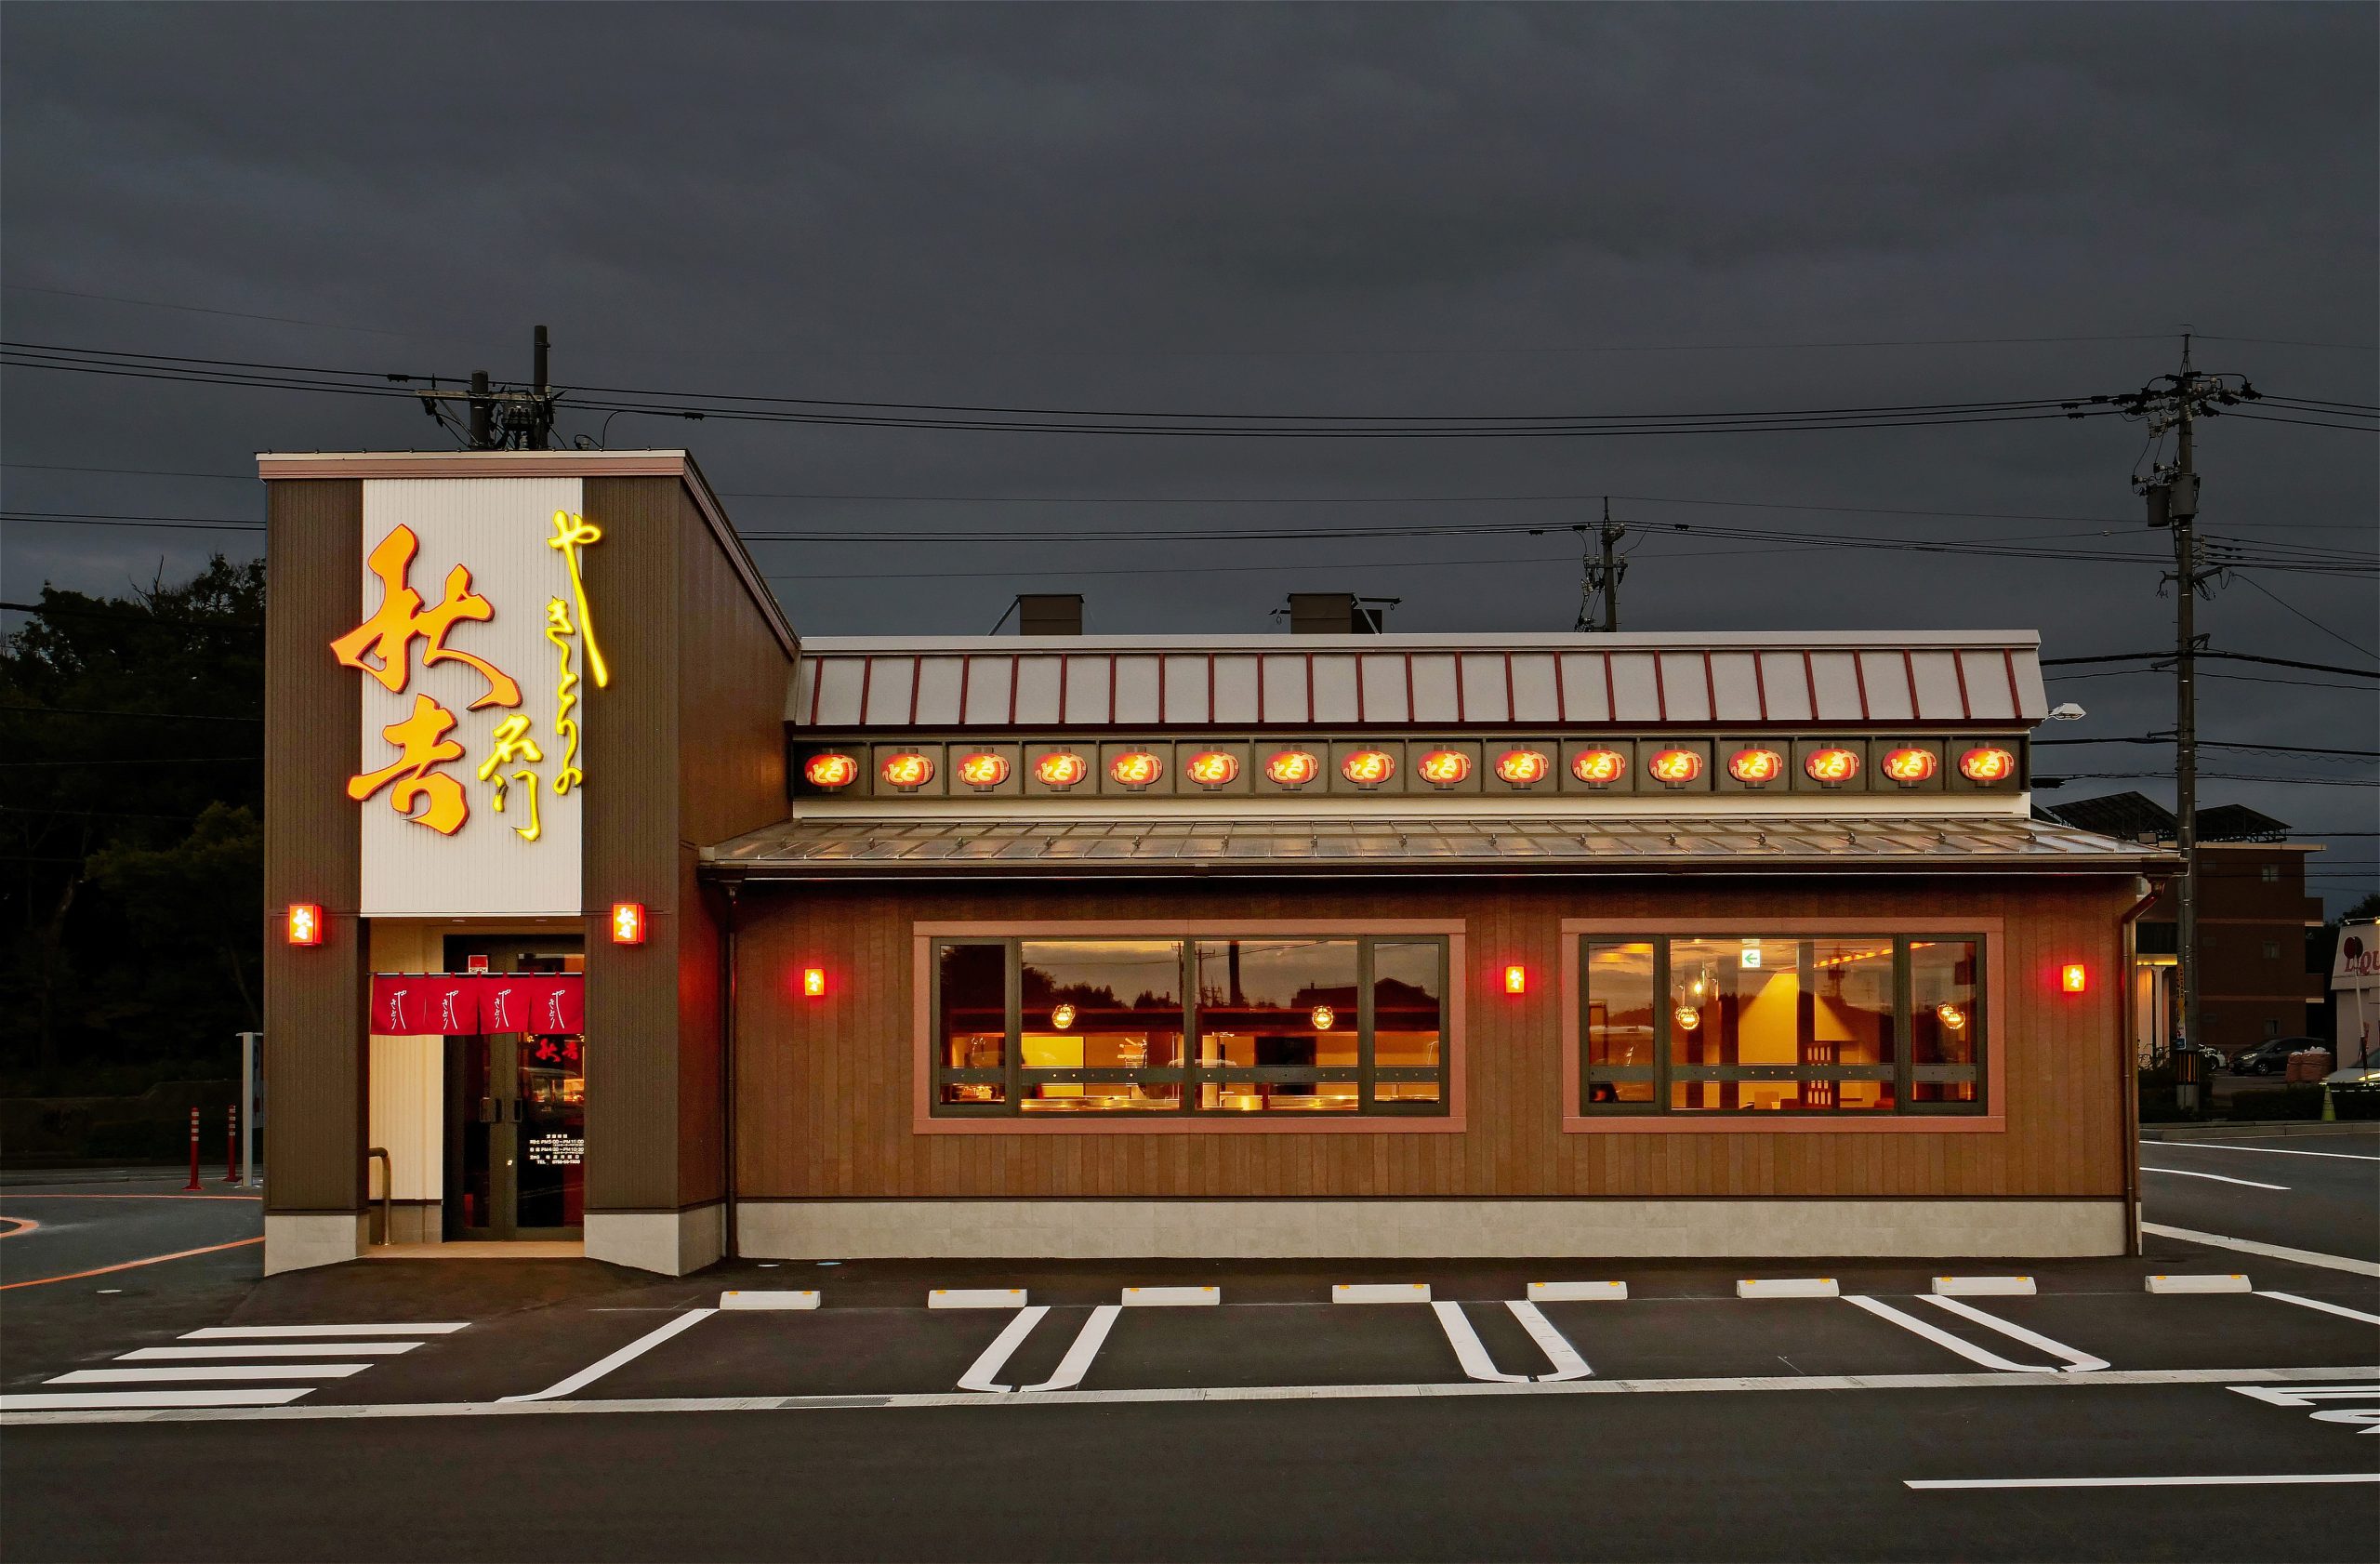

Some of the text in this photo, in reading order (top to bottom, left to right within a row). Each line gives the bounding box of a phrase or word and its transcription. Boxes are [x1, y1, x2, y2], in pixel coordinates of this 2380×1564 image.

[329, 523, 524, 837] 秋吉
[478, 714, 543, 842] 名門
[546, 509, 608, 795] やきとりの
